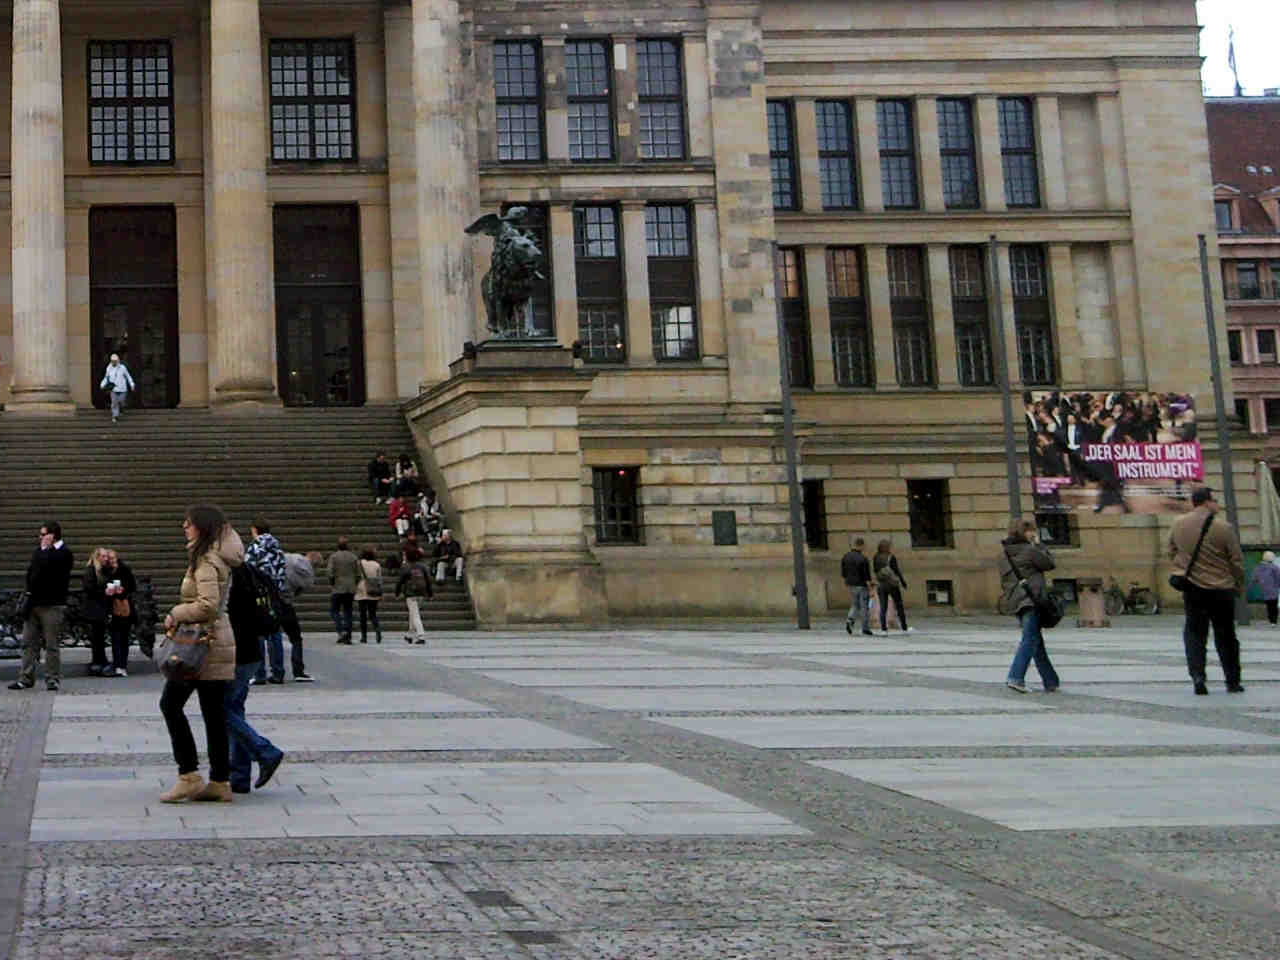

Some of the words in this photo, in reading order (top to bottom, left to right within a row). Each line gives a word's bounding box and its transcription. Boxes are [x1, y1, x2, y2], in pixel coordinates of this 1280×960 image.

[1114, 444, 1143, 460] SAAL
[1144, 444, 1162, 460] IST
[1165, 443, 1196, 460] MEIN
